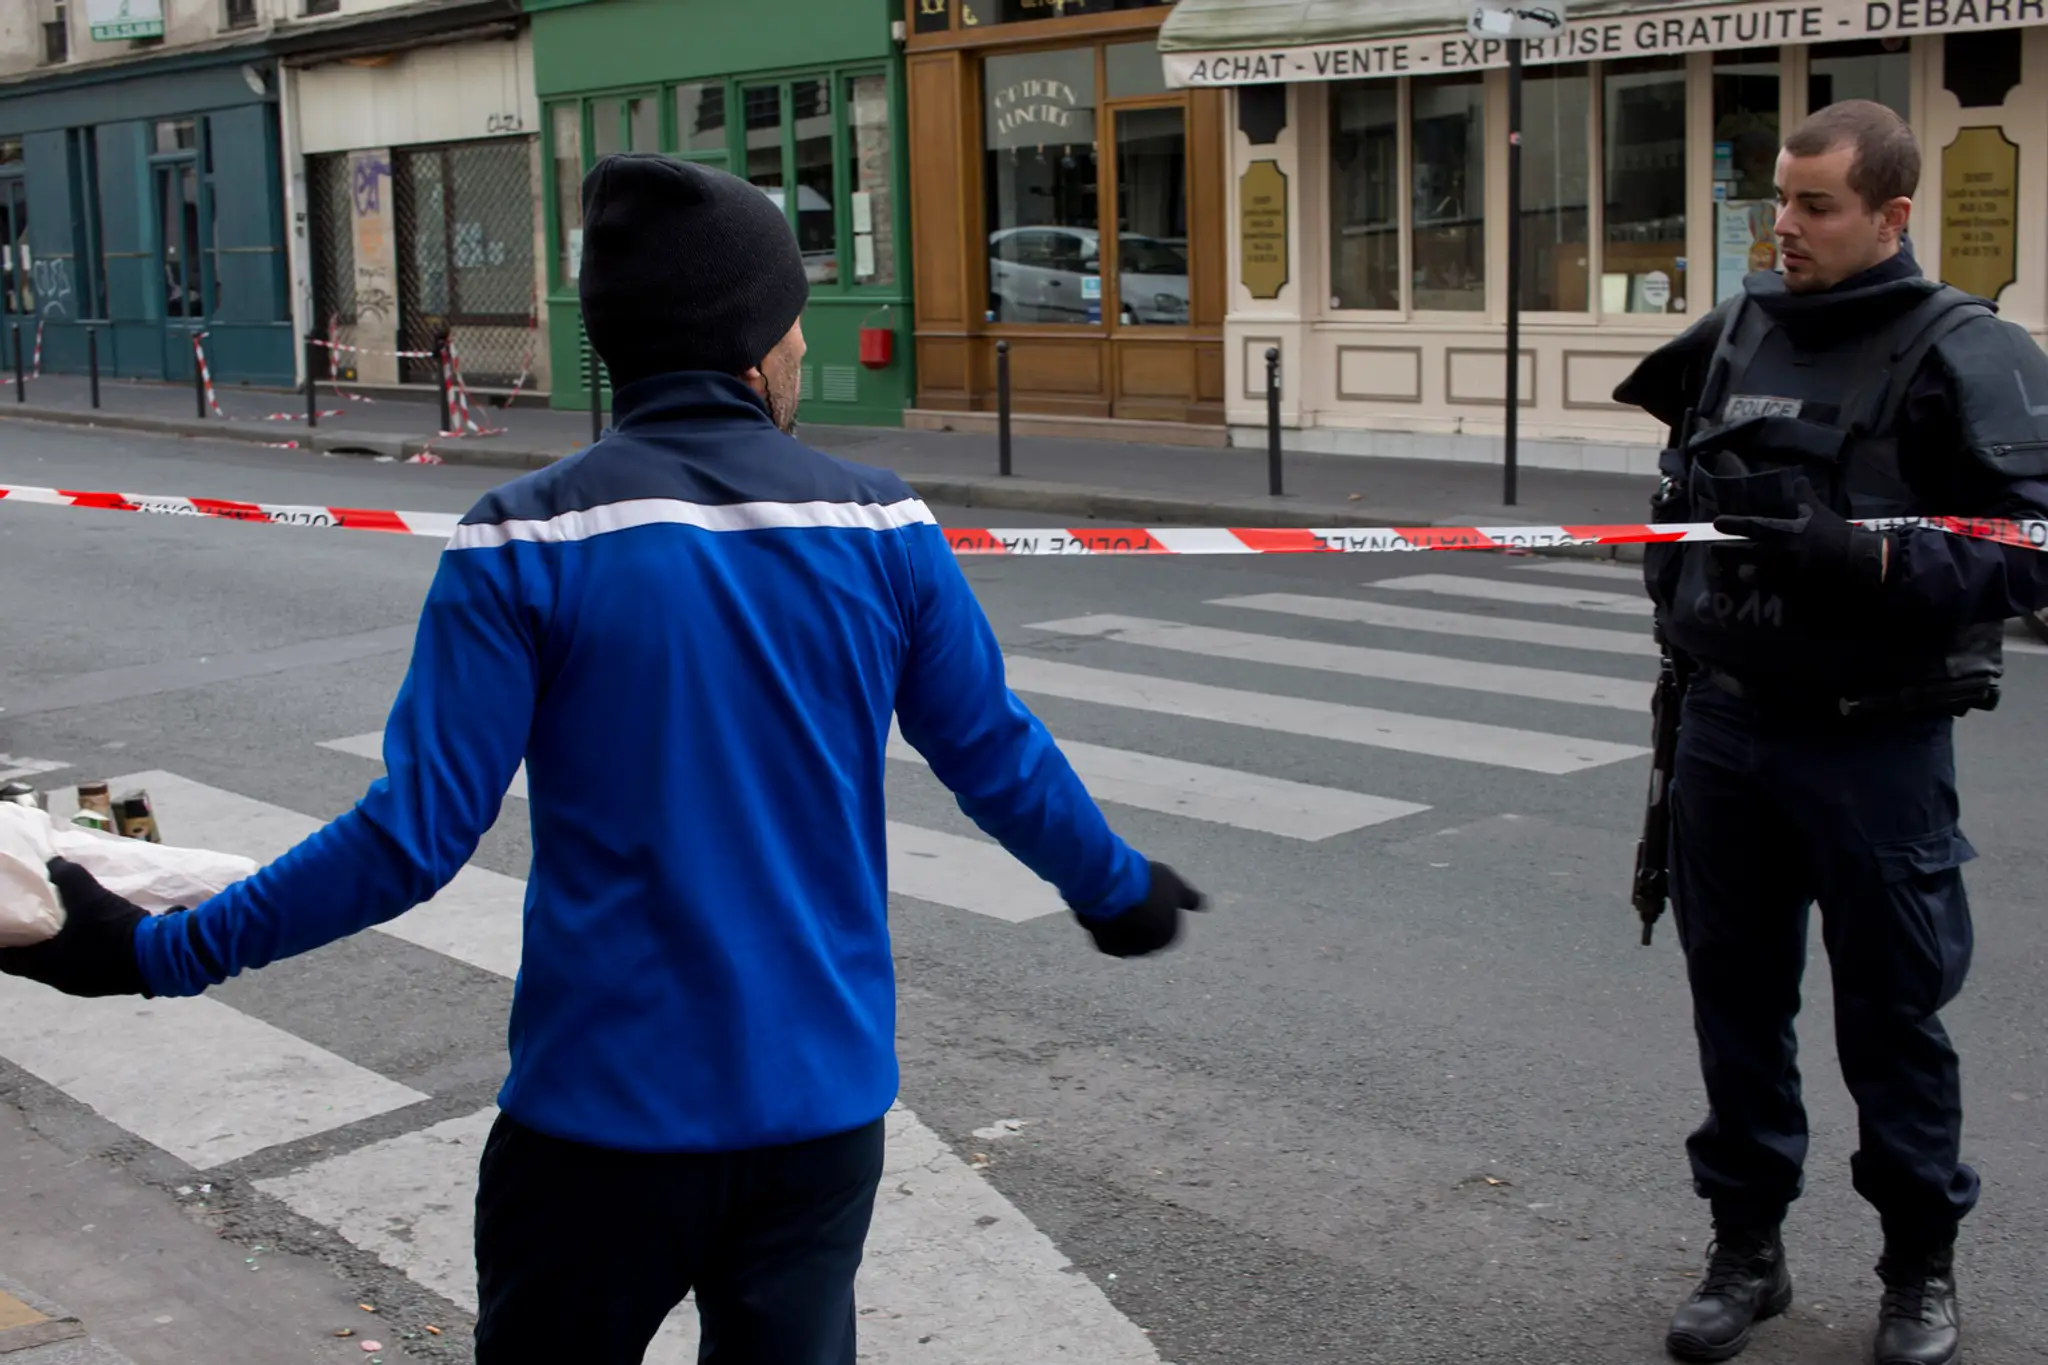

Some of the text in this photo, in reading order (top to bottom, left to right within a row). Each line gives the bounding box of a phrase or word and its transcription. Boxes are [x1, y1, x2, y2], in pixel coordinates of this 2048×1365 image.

[1189, 53, 1286, 81] ACHAT
[1313, 45, 1408, 76] VENTE
[1441, 25, 1622, 67] EXPRISE
[1635, 8, 1822, 49] GRATUITE
[1730, 399, 1794, 418] POLICE
[1050, 537, 1149, 555] POLICE
